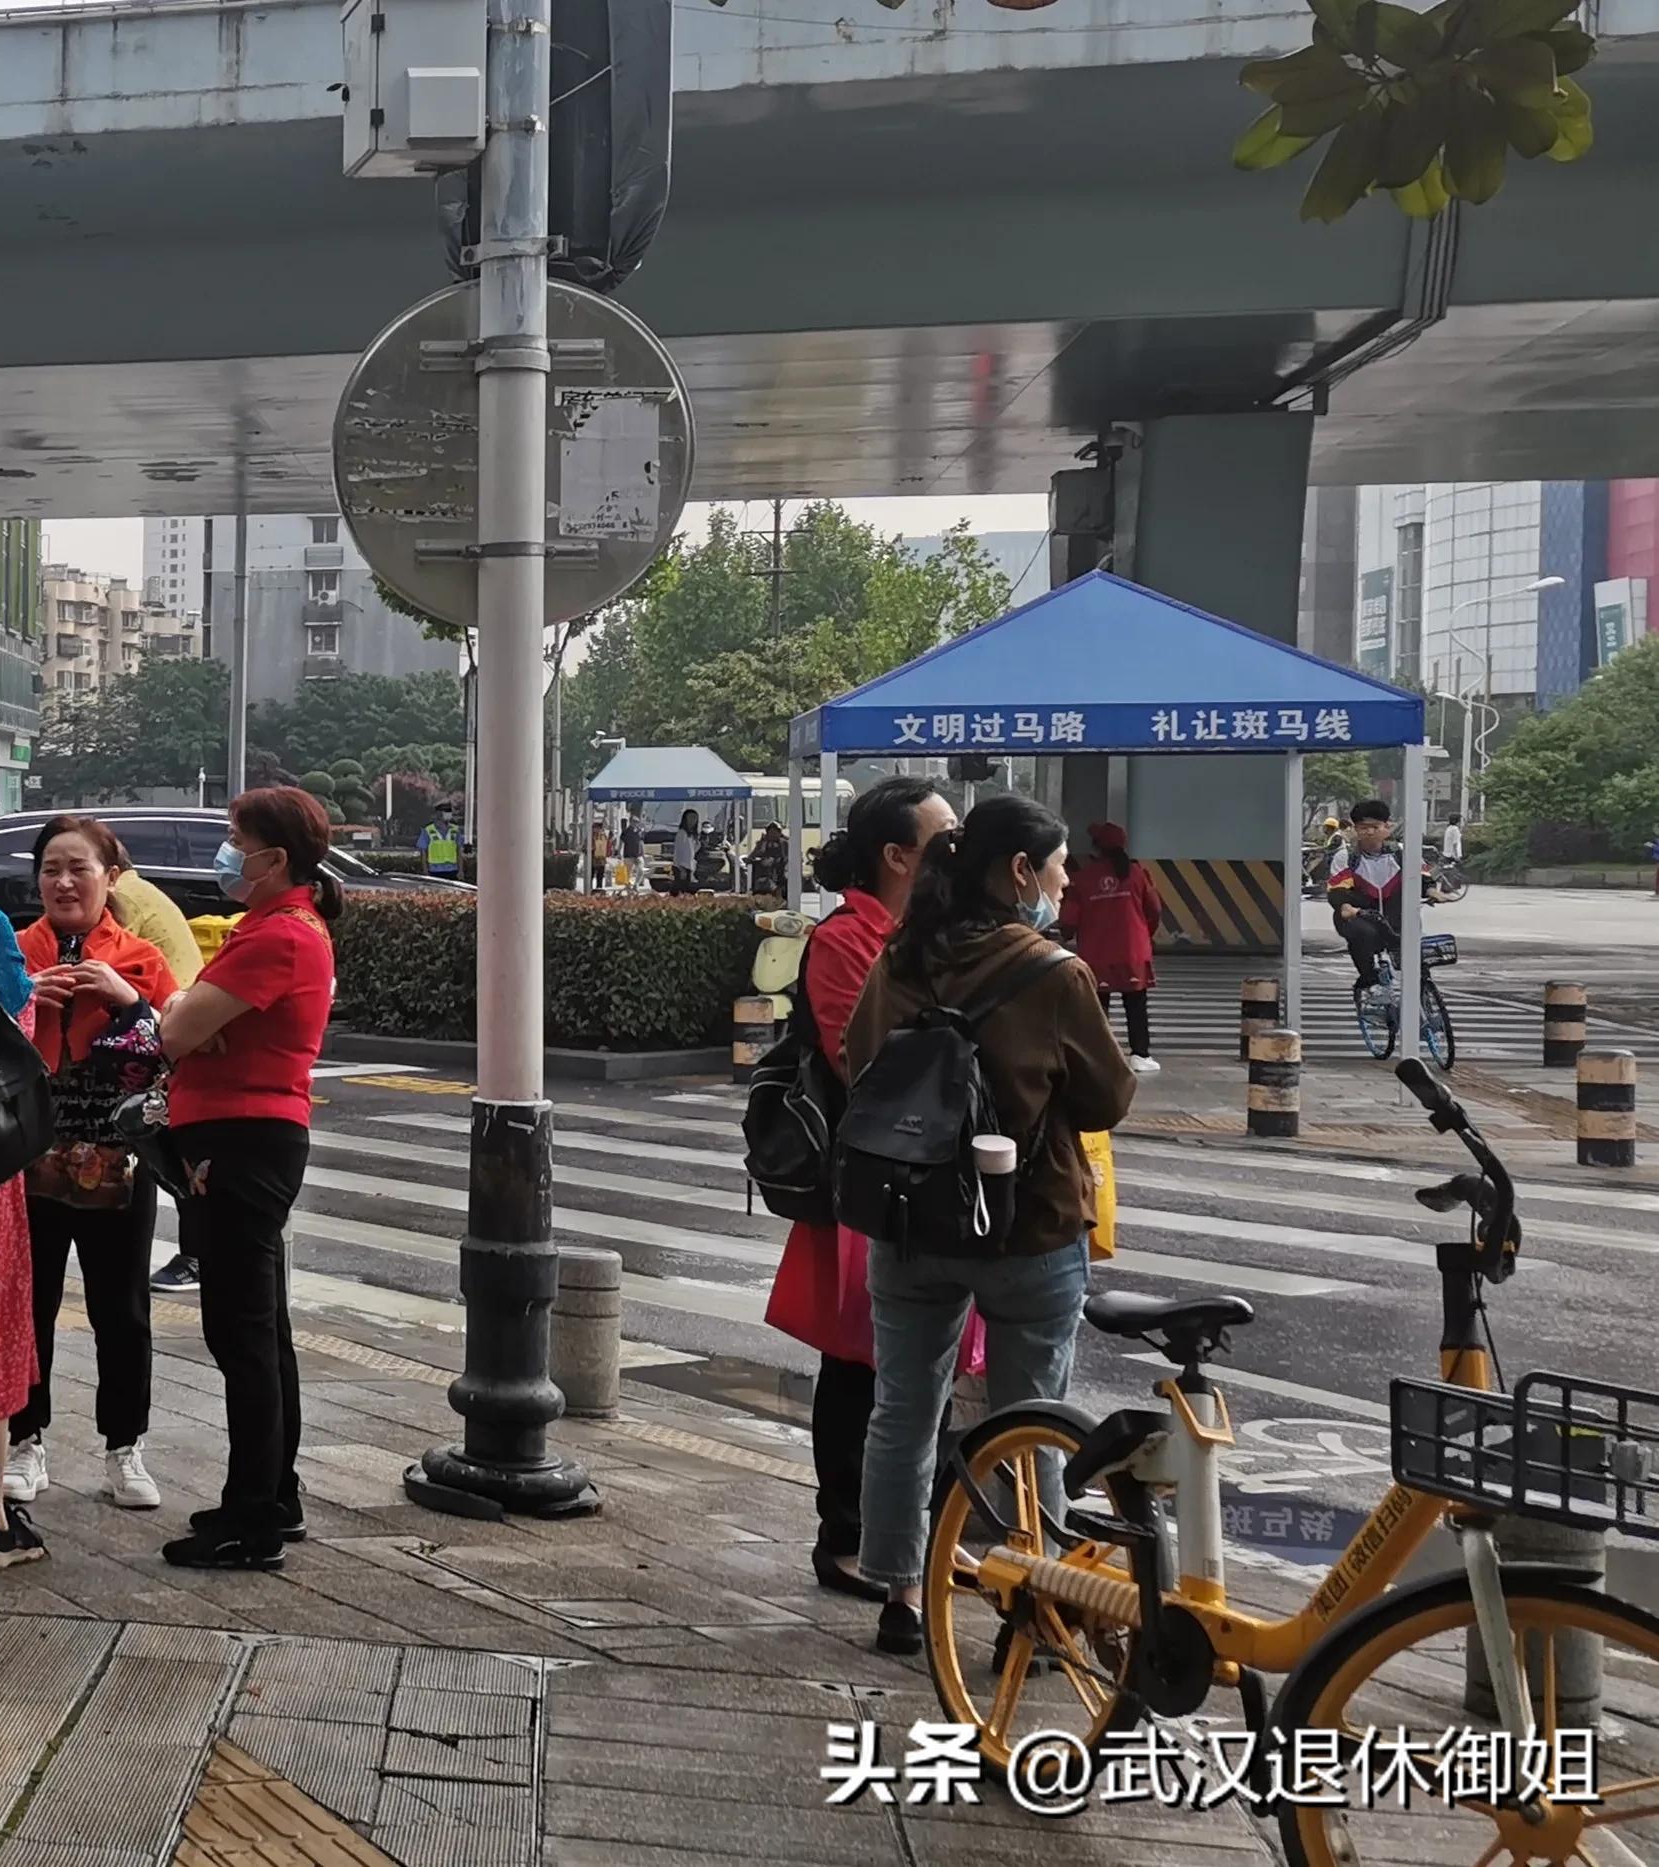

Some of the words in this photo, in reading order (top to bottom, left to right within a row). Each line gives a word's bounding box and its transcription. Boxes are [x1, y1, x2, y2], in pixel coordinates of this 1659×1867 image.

[893, 711, 1086, 744] 文明过马路
[1151, 709, 1352, 741] 礼让斑马线
